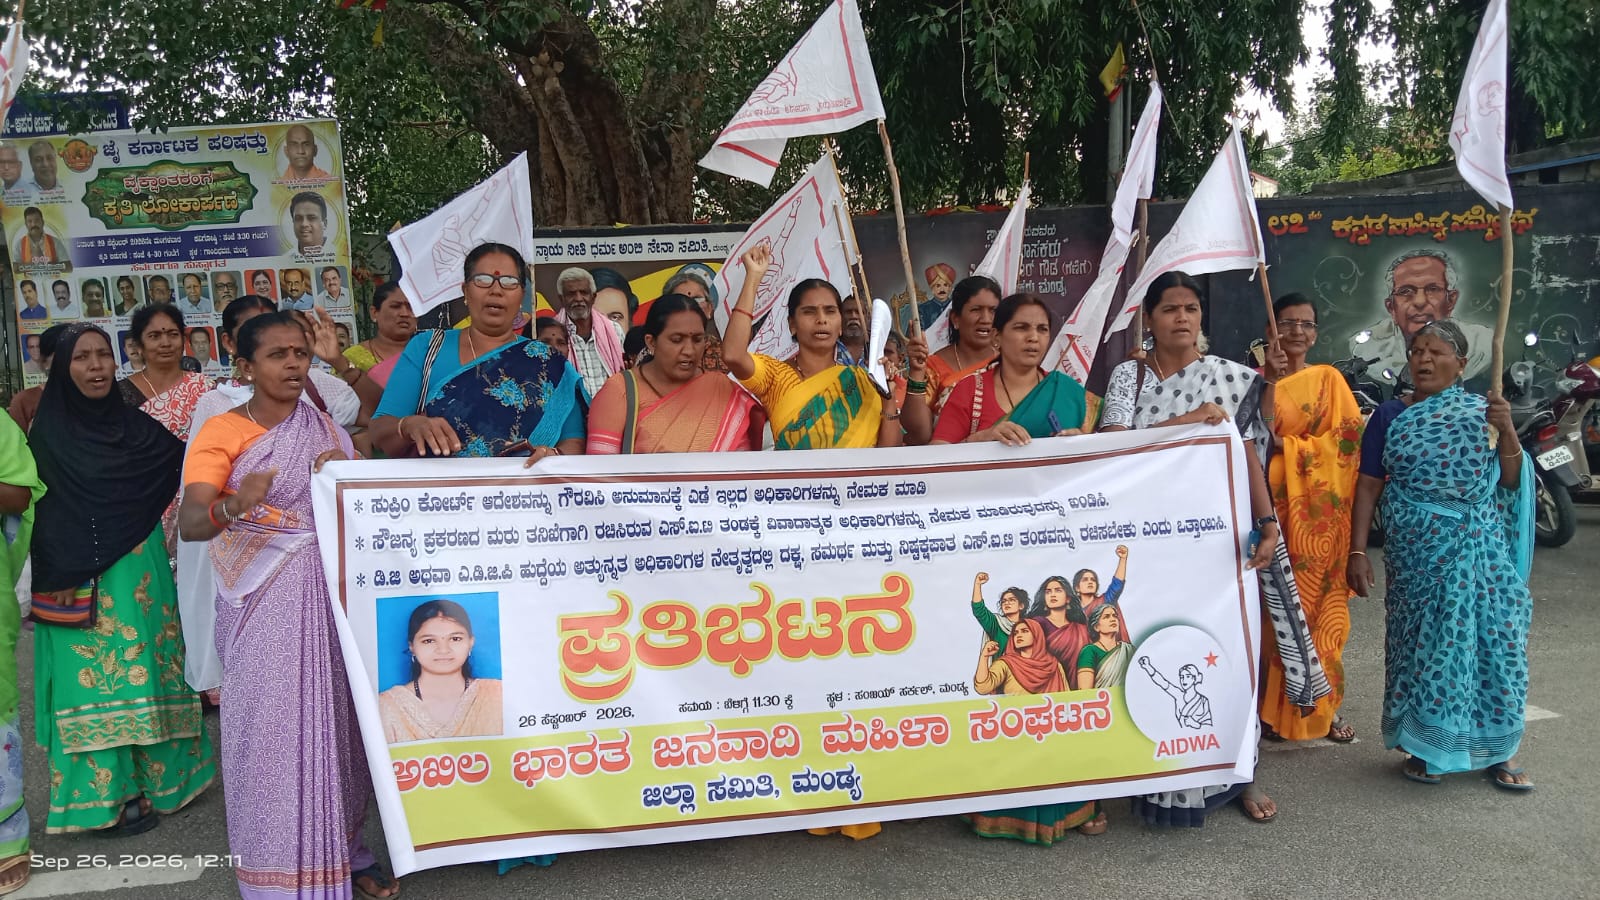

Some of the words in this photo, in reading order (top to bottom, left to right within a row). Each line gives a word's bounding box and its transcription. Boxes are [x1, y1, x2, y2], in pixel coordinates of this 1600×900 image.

[103, 140, 120, 163] ಜೈ
[128, 136, 198, 155] ಕರ್ನಾಟಕ
[208, 131, 267, 154] ಪರಿಷತ್ತು
[104, 198, 133, 223] ಕೃತಿ
[142, 191, 239, 214] ಲೋಕಾರ್ಪಣೆ
[1331, 213, 1388, 245] ಕನ್ನಡ
[1388, 211, 1450, 241] ಸಾಹಿತ್ಯ
[535, 242, 563, 261] ನ್ಯಾಯ
[568, 243, 586, 256] ನೀತಿ
[591, 241, 616, 258] ಧರ್ಮ
[648, 239, 674, 253] ಸೇನಾ
[679, 238, 711, 253] ಸಮಿತಿ.
[418, 491, 476, 512] ಕೋರ್ಟ್
[482, 491, 552, 515] ಆದೇಶವನ್ನು
[558, 487, 605, 508] ಗೌರವಿಸಿ
[612, 486, 682, 511] ಅನುಮಾನಕ್ಕೆ
[688, 485, 709, 502] ಎಡೆ
[716, 484, 748, 508] ಇಲ್ಲದ
[754, 483, 841, 506] ಅಧಿಕಾರಿಗಳನ್ನು
[847, 481, 889, 499] ನೇಮಕ
[895, 479, 926, 496] ಮಾಡಿ
[372, 528, 417, 557] ಸೌಜನ್ಯ
[424, 528, 480, 554] ಪ್ರಕರಣದ
[487, 527, 519, 545] ಮರು
[526, 523, 588, 544] ತನಿಖೆಗಾಗಿ
[595, 519, 652, 539] ರಚಿಸಿರುವ
[658, 516, 713, 536] ಎಸ್.ಐ.ಟಿ
[720, 514, 761, 539] ತಂಡಕ್ಕೆ
[766, 513, 833, 535] ವಿವಾದಾತ್ಮಕ
[839, 510, 926, 530] ಅಧಿಕಾರಿಗಳನ್ನು
[929, 507, 971, 524] ನೇಮಕ
[977, 500, 1065, 518] ಮಾಡಿರುವುದನ್ನು
[373, 567, 401, 587] ಡಿ.ಜಿ
[409, 565, 451, 587] ಅಥವಾ
[458, 563, 513, 582] ಎ.ಡಿ.ಜಿ.ಪಿ
[520, 558, 567, 586] ಹುದ್ದೆಯ
[574, 554, 627, 583] ಅತ್ಯುನ್ನತ
[634, 552, 704, 573] ಅಧಿಕಾರಿಗಳ
[711, 547, 773, 575] ನೇತೃತ್ವದಲ್ಲಿ
[780, 545, 805, 570] ದಕ್ಷ,
[810, 542, 855, 562] ಸಮರ್ಥ
[862, 539, 892, 563] ಮತ್ತು
[963, 530, 1013, 550] ಎಸ್.ಐ.ಟಿ
[1019, 525, 1075, 549] ತಂಡವನ್ನು
[1080, 521, 1136, 541] ರಚಿಸಬೇಕು
[1142, 517, 1172, 536] ಎಂದು
[1177, 516, 1227, 539] ಒತ್ತಾಯಿಸಿ.
[560, 573, 914, 701] ಪ್ರತಿಭಟನೆ
[518, 715, 537, 728] 26
[678, 701, 713, 713] ಸಮಯ
[752, 695, 780, 708] 11.30
[784, 694, 793, 710] ಕ್ಕೆ
[826, 692, 843, 709] ಸ್ಥಳ
[854, 686, 895, 701] ಸಂಜಯ್
[939, 682, 969, 697] ಮಂಡ್ಯ
[392, 753, 490, 792] ಅಖಿಲ
[513, 730, 631, 787] ಭಾರತ
[653, 722, 800, 769] ಜನವಾದಿ
[822, 712, 949, 755] ಮಹಿಳಾ
[969, 691, 1112, 742] ಸಂಘಟನೆ
[1157, 734, 1220, 757] AIDWA
[643, 781, 695, 812] ಜಿಲ್ಲಾ
[708, 774, 779, 803] ಸಮಿತಿ,
[792, 764, 861, 802] ಮಂಡ್ಯ
